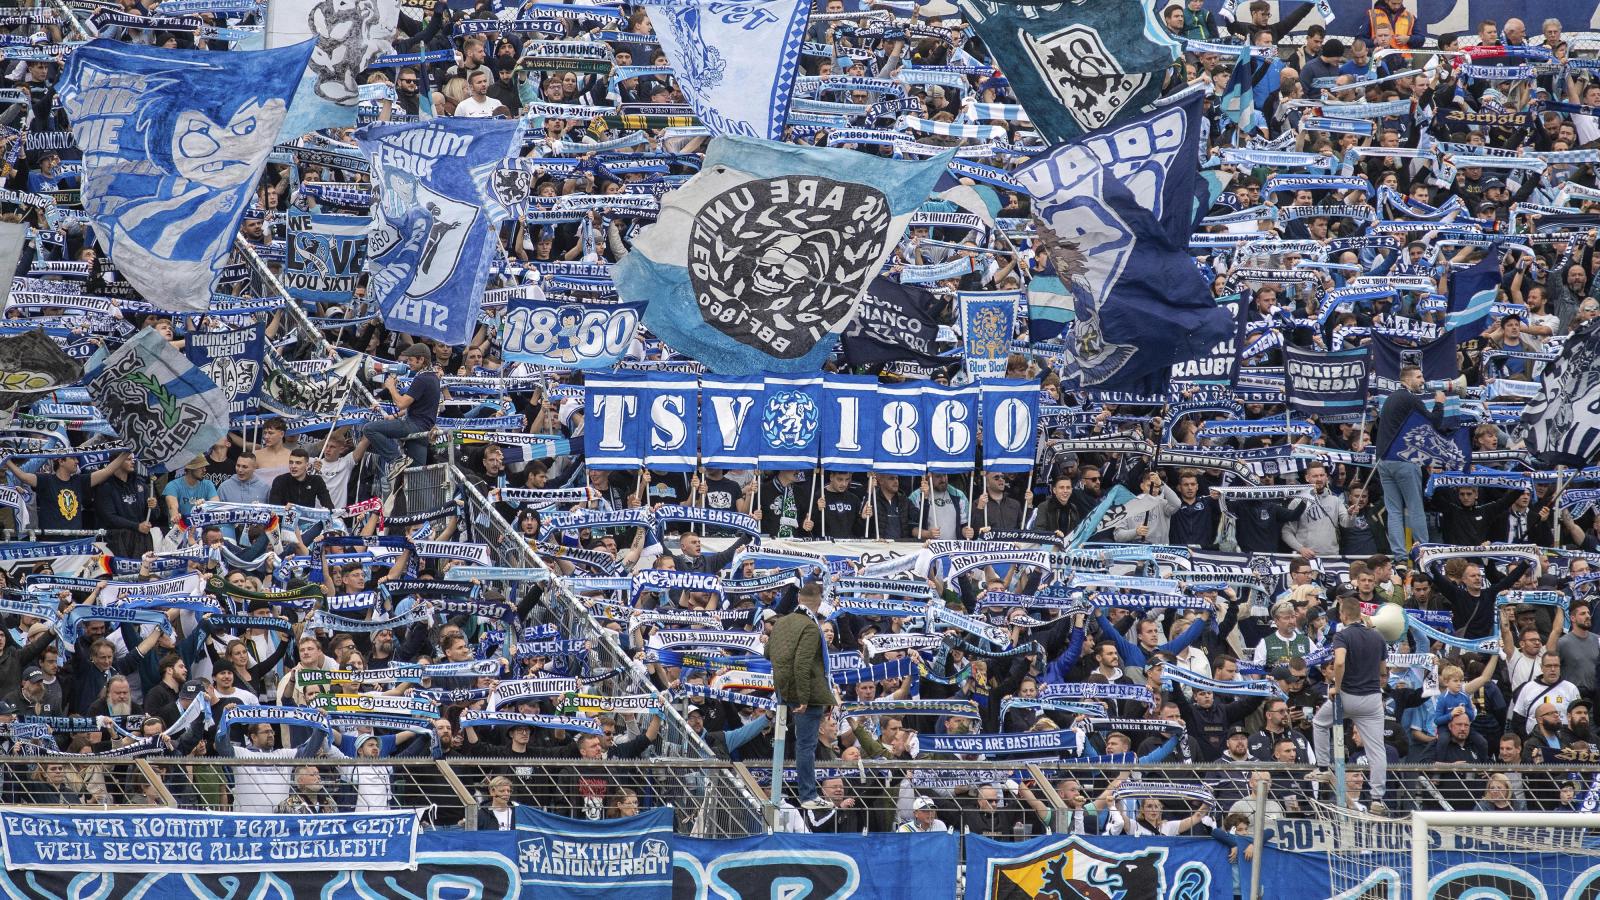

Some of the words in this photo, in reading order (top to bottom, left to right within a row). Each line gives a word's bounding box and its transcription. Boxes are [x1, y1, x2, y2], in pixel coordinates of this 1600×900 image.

[112, 14, 143, 24] VEREIN
[162, 18, 179, 26] FÜR
[459, 23, 489, 32] TSV
[521, 22, 563, 33] 1860
[853, 28, 881, 37] Feeling
[542, 44, 565, 56] 1860
[801, 42, 821, 54] SV
[1, 91, 19, 99] HEN
[529, 106, 565, 115] 1860
[1445, 111, 1526, 125] Sechzig
[843, 131, 867, 141] 1860
[565, 198, 597, 207] 1860
[601, 195, 650, 206] München
[1293, 205, 1319, 216] 1860
[1321, 206, 1371, 218] MÜNCHEN
[288, 216, 312, 231] WE
[539, 264, 566, 275] COPS
[568, 265, 587, 274] ARE
[590, 266, 608, 276] BAS
[288, 273, 318, 290] YOU
[11, 293, 37, 304] 1860
[505, 309, 636, 354] 1860
[191, 330, 256, 347] MÜNCHENS
[207, 342, 244, 357] JUGEND
[630, 363, 653, 371] der
[969, 362, 985, 373] Blue
[1289, 362, 1360, 378] POLIZIA
[1295, 377, 1355, 390] MERDA
[39, 402, 88, 415] NCHENS
[18, 419, 57, 431] 1860
[593, 395, 754, 451] TSV
[835, 397, 1031, 456] 1860
[1470, 476, 1493, 485] für
[388, 515, 408, 525] 1860
[556, 512, 584, 525] COPS
[587, 511, 605, 522] ARE
[657, 505, 684, 518] COPS
[687, 508, 704, 520] ARE
[707, 510, 759, 532] BASTARDS
[996, 531, 1019, 539] 1860
[745, 545, 759, 553] TSV
[930, 543, 951, 554] 1860
[1423, 548, 1444, 557] TSV
[1447, 546, 1472, 554] 1860
[1488, 545, 1536, 556] MÜNCHEN
[949, 557, 975, 572] 1860
[739, 579, 759, 587] 1860
[761, 573, 795, 585] MÜNCHEN
[1190, 574, 1212, 583] 1860
[387, 583, 400, 591] TSV
[402, 582, 423, 591] 1860
[857, 581, 879, 589] 1860
[881, 582, 929, 594] MÜNCHEN
[874, 601, 898, 611] für
[1112, 594, 1144, 606] 1860
[1146, 594, 1208, 610] MÜNCHEN
[91, 607, 136, 619] sechzig
[225, 617, 246, 625] 1860
[247, 617, 291, 630] MÜNCHEN
[321, 616, 335, 624] TSV
[659, 634, 686, 646] 1860
[323, 671, 349, 680] SIND
[363, 670, 384, 678] DER
[741, 678, 763, 687] 1860
[497, 683, 523, 698] 1860
[330, 698, 358, 708] SIND
[374, 700, 396, 709] DER
[572, 698, 599, 708] SIND
[613, 699, 634, 708] DER
[635, 699, 659, 709] VER
[266, 707, 287, 718] für
[465, 711, 494, 721] Wir
[498, 712, 526, 721] sind
[531, 714, 554, 723] der
[1109, 723, 1137, 731] IMMER
[934, 738, 952, 749] ALL
[955, 738, 983, 750] COPS
[985, 737, 1004, 749] ARE
[1006, 733, 1060, 748] BASTARDS
[8, 817, 67, 837] EGAL
[72, 818, 127, 837] WER
[235, 820, 290, 838] EGAL
[298, 819, 346, 837] WER
[36, 842, 97, 861] WEIL
[103, 841, 203, 863] SECHZIG
[209, 841, 263, 861] ALLE
[269, 839, 387, 860] ÜBERLEBT!
[551, 841, 633, 860] SEKTION
[518, 858, 667, 877] STADIONVERBOT
